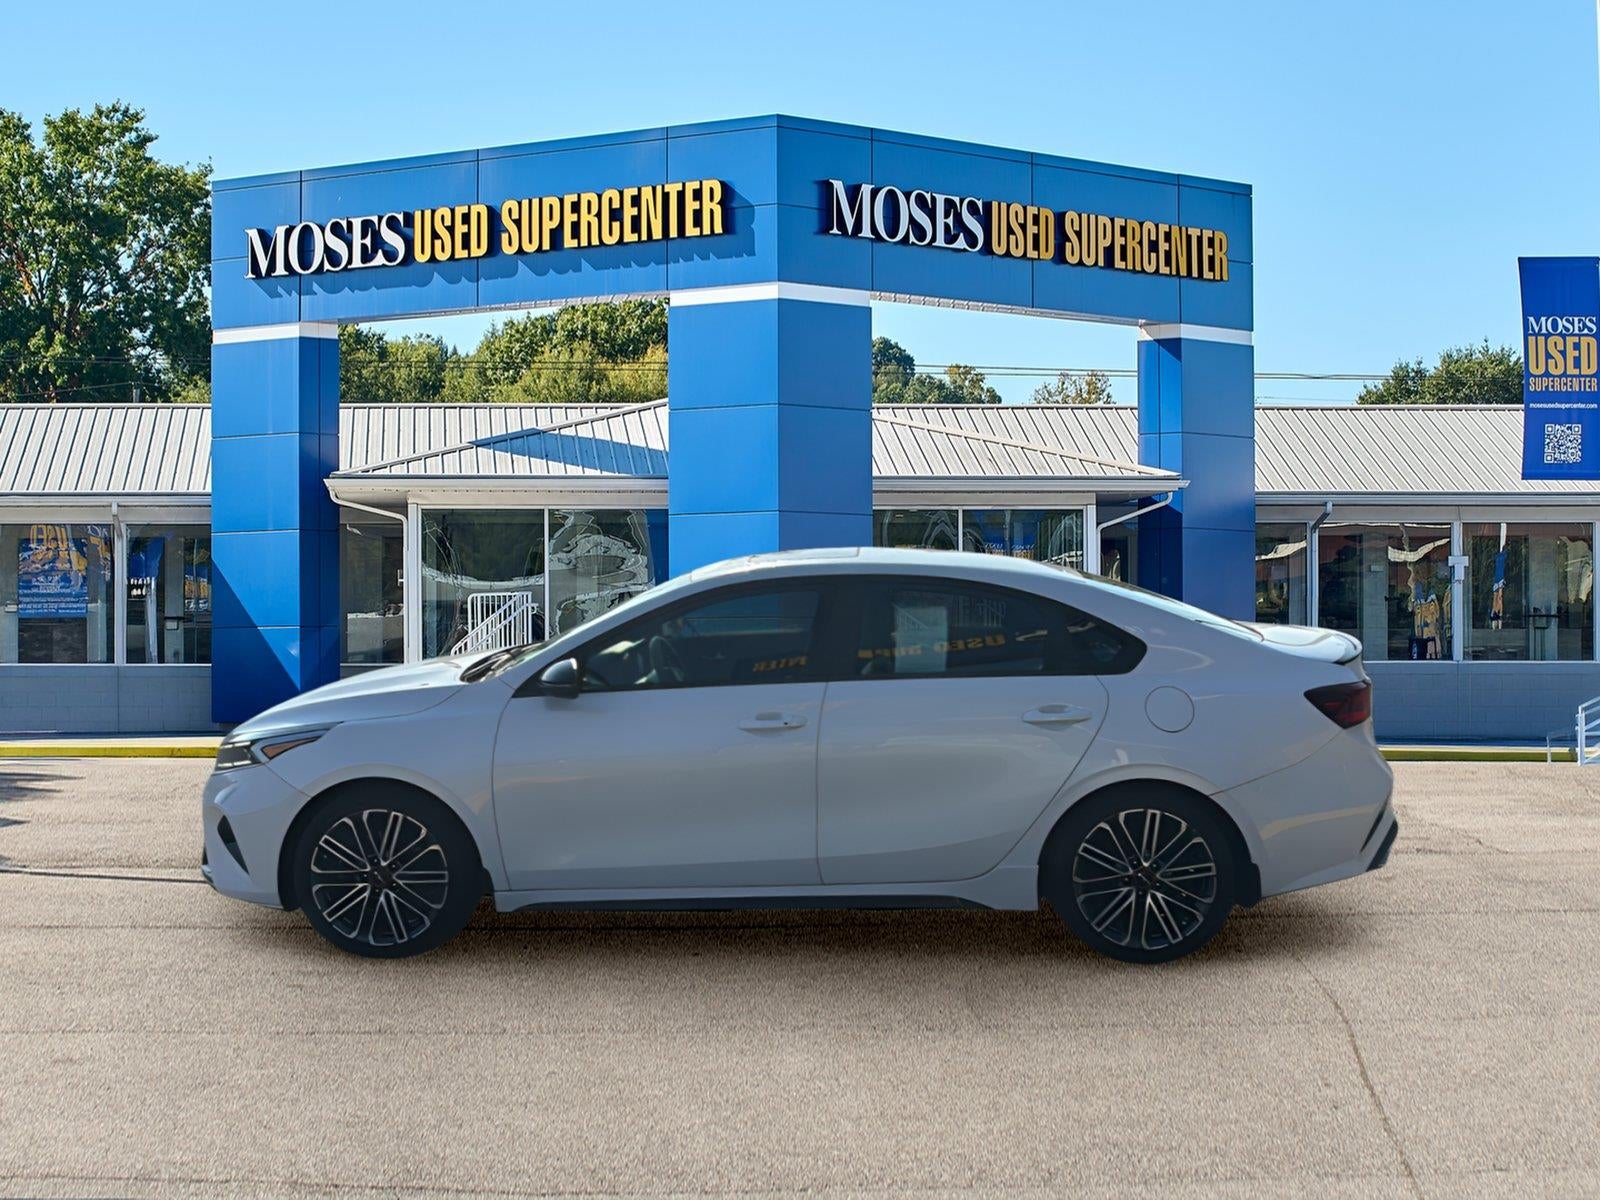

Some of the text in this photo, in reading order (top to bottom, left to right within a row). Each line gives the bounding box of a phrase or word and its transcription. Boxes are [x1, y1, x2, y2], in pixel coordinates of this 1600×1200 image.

[244, 178, 724, 280] MOSES USED SUPERCENTER
[828, 179, 1229, 282] MOSES USED SUPERCENTER
[1528, 316, 1597, 334] MOSES
[1528, 336, 1597, 375] USED
[1529, 377, 1597, 391] SUPERCENTER
